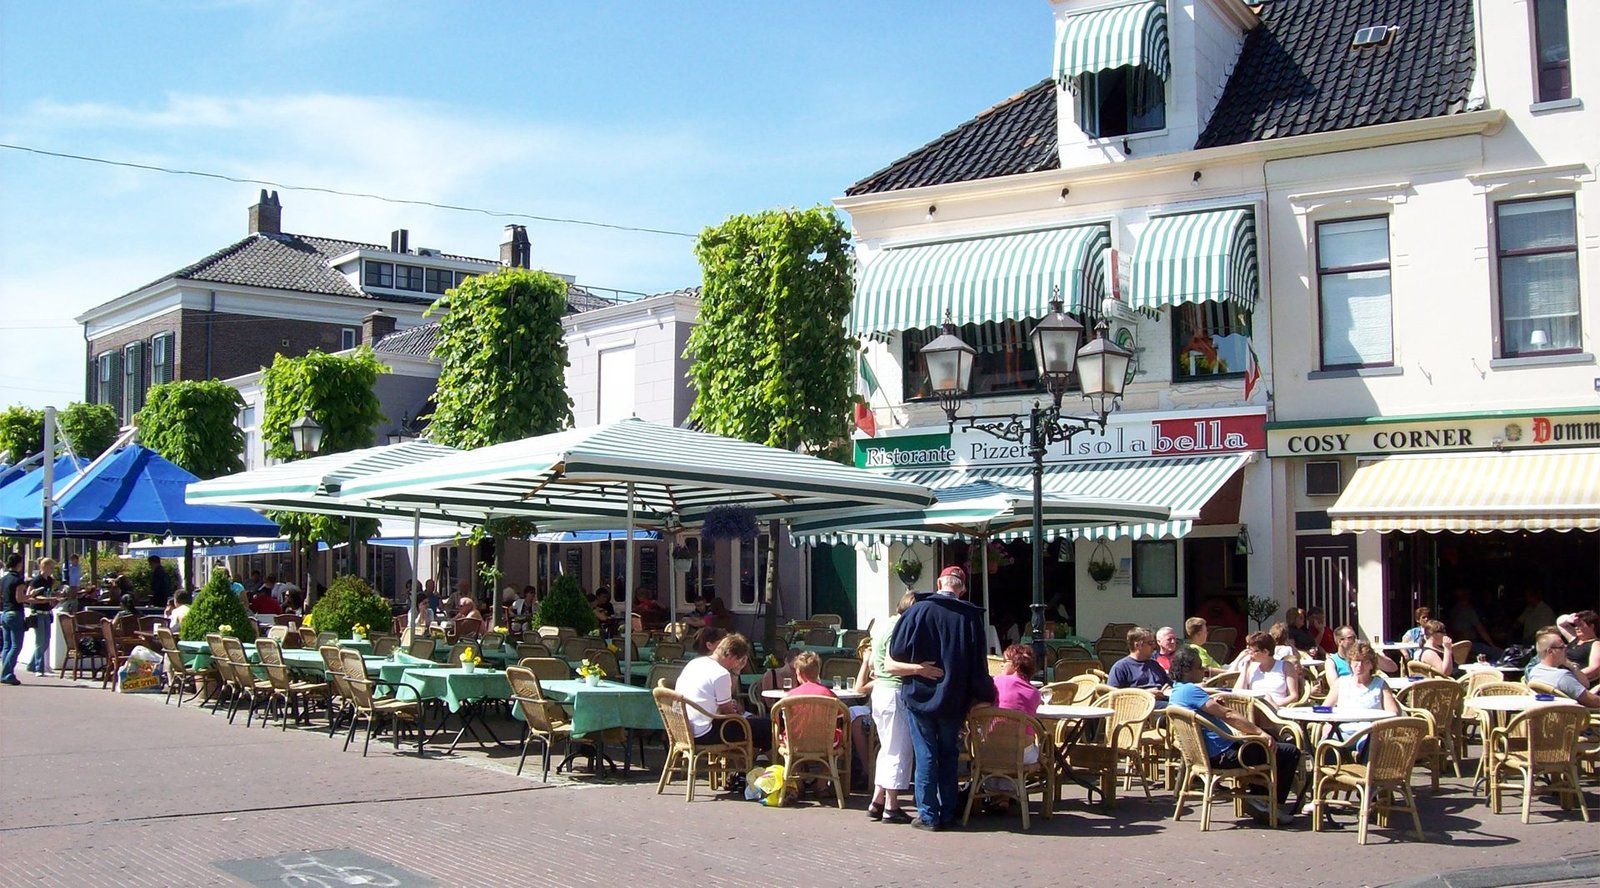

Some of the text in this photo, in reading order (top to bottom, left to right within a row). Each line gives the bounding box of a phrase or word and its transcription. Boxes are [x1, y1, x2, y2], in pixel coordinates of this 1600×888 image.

[1287, 428, 1473, 453] COSY CORNER
[866, 446, 956, 466] Ristorante
[970, 442, 1030, 460] Pizzer
